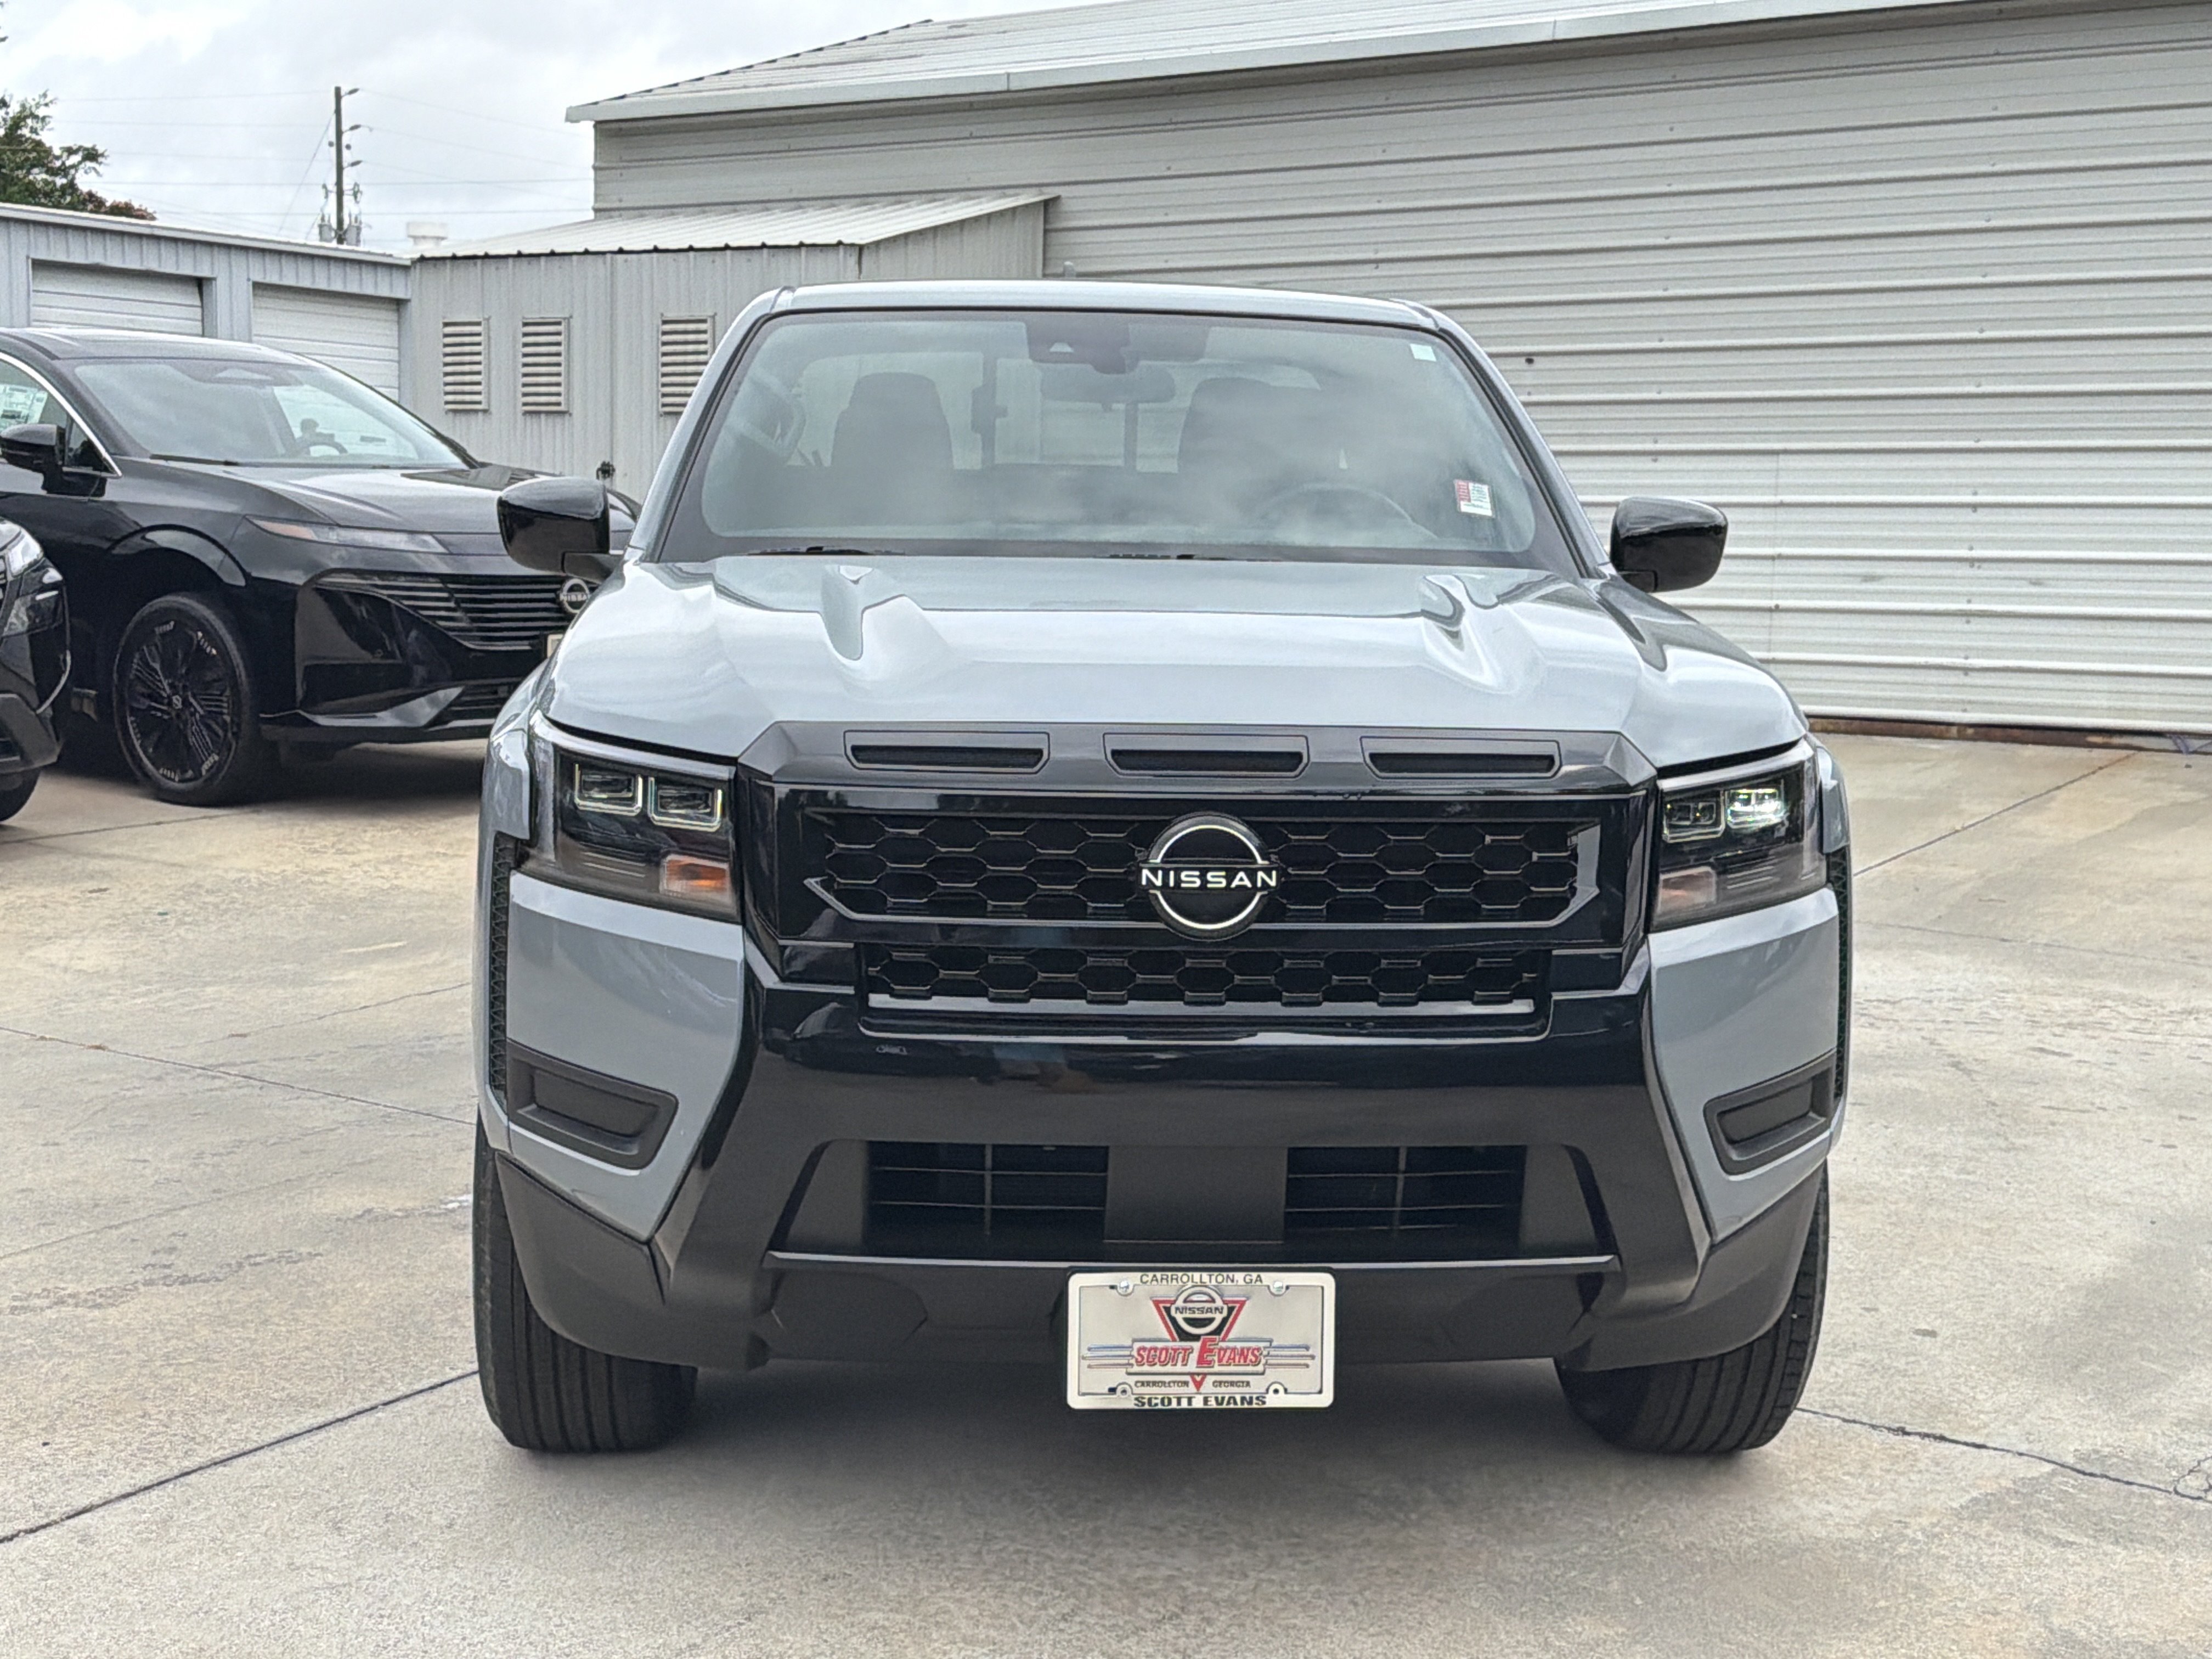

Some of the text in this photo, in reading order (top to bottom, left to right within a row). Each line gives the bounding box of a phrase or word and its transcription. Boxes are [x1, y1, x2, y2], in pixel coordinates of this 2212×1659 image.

[1141, 868, 1277, 888] NISSAN
[1140, 1273, 1262, 1284] CARROLLTON, GA
[1174, 1306, 1224, 1314] NISSAN
[1135, 1336, 1262, 1368] SCOTT EVANS
[1134, 1396, 1266, 1407] SCOTT EVANS
